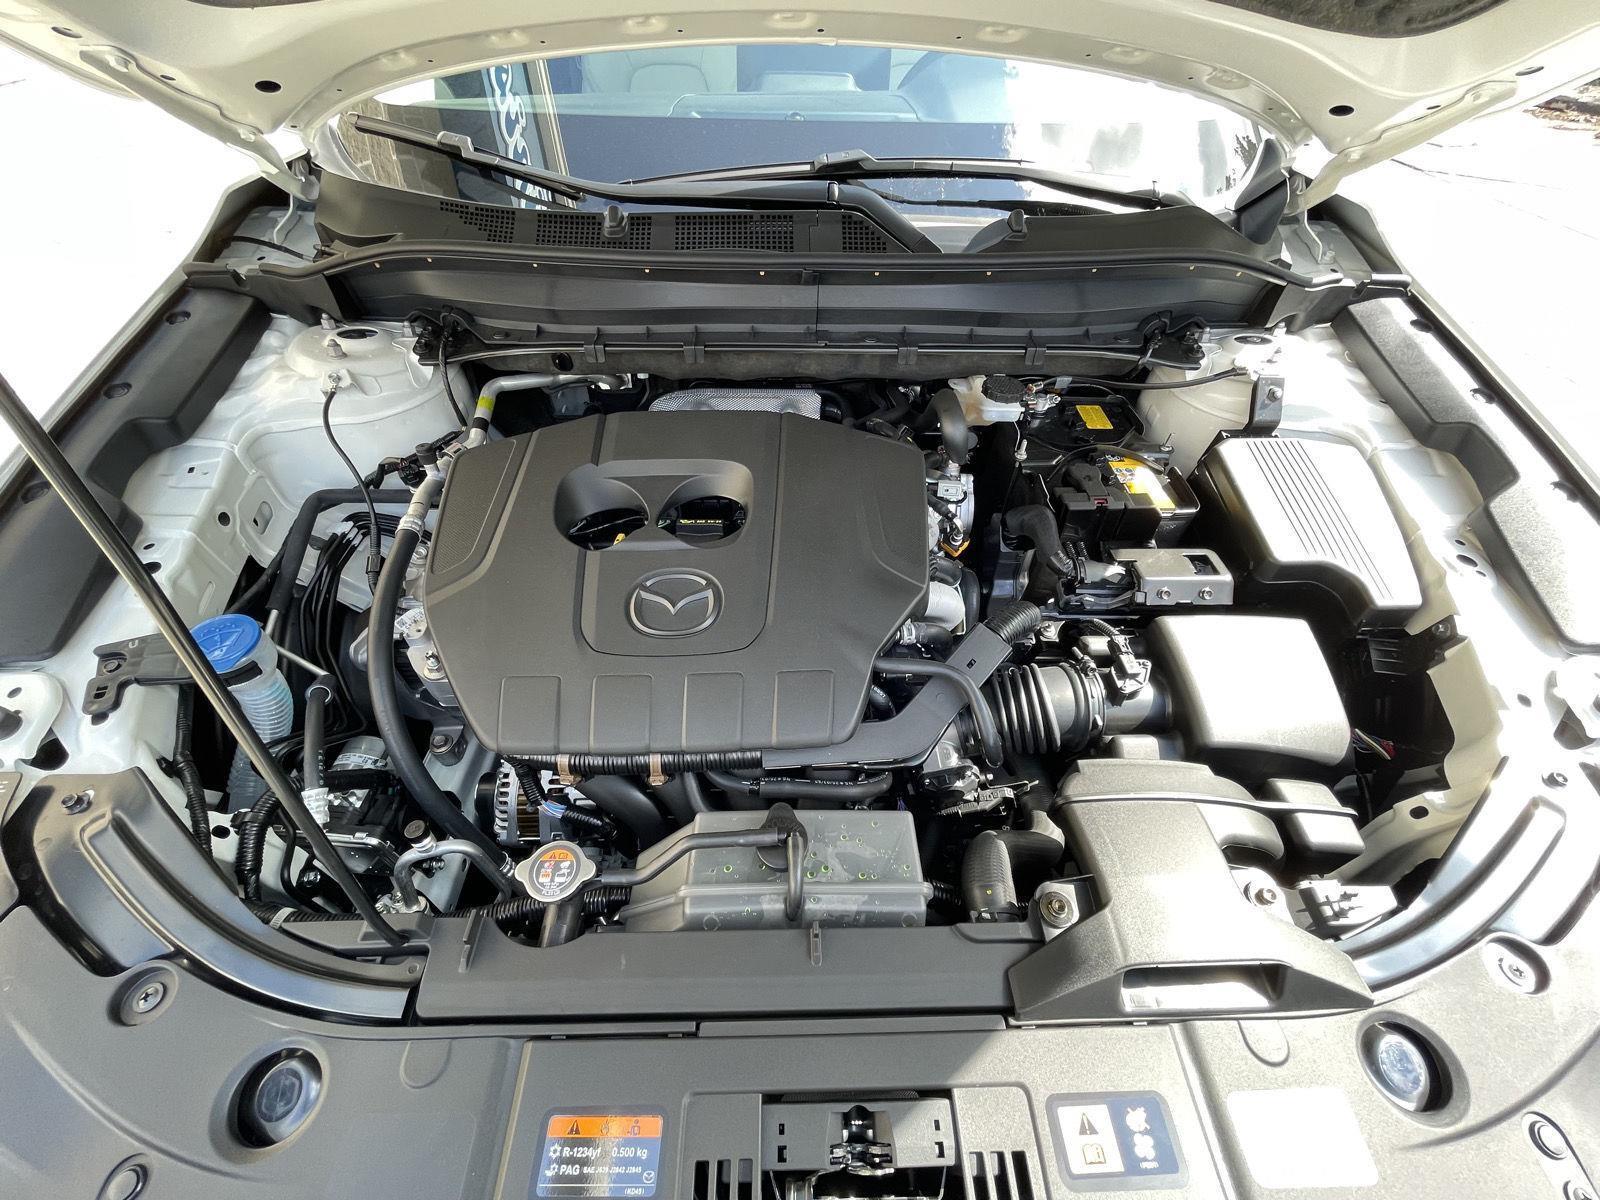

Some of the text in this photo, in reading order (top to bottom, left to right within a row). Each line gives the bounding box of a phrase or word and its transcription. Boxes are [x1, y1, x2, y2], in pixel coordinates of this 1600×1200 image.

[562, 1146, 648, 1160] R-1234yf 0.500 kg
[559, 1164, 580, 1175] PAG
[583, 1166, 595, 1174] SAE
